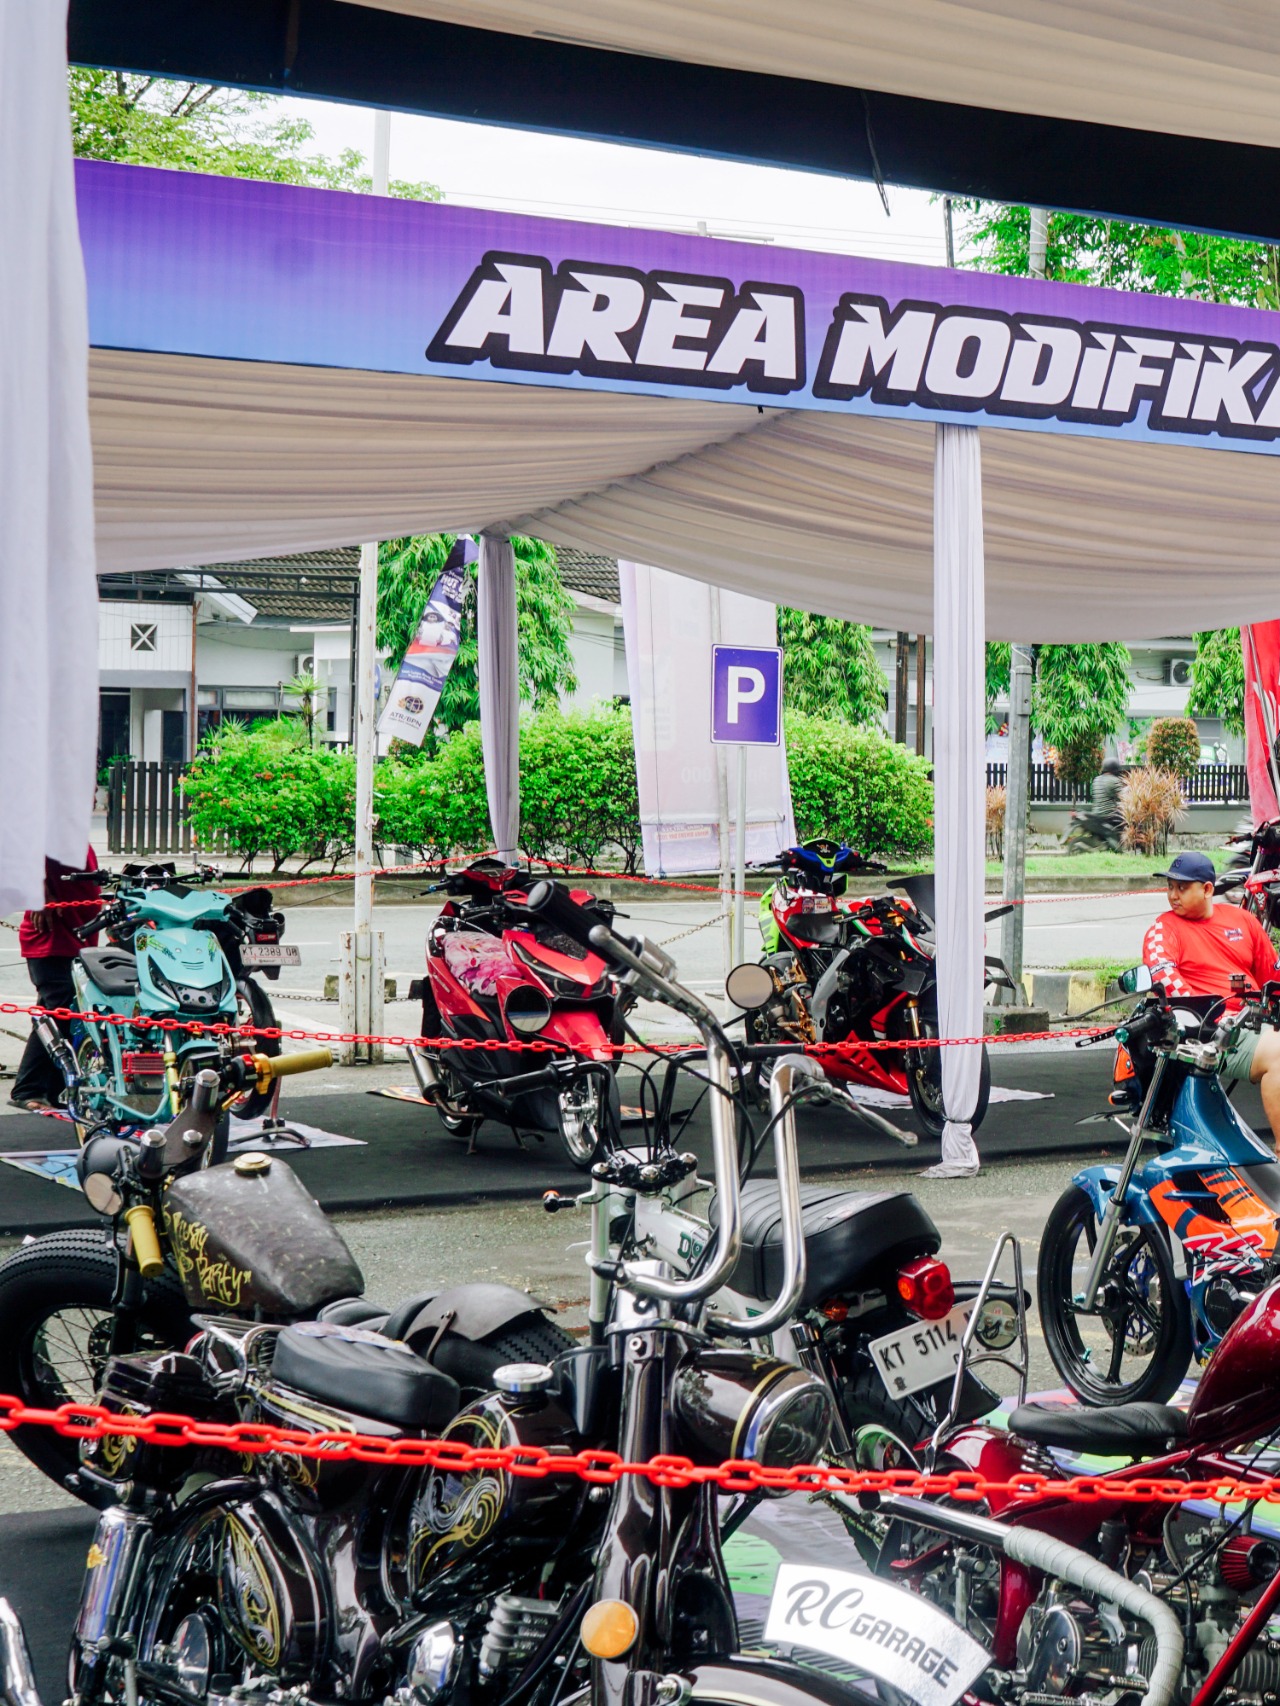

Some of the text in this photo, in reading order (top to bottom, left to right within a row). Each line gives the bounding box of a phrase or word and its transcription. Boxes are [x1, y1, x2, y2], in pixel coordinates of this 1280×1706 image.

[444, 262, 798, 381] AREA
[727, 665, 766, 724] P
[879, 1342, 906, 1372] KT
[912, 1319, 958, 1357] 5114
[784, 1579, 959, 1689] RC GARAGE
